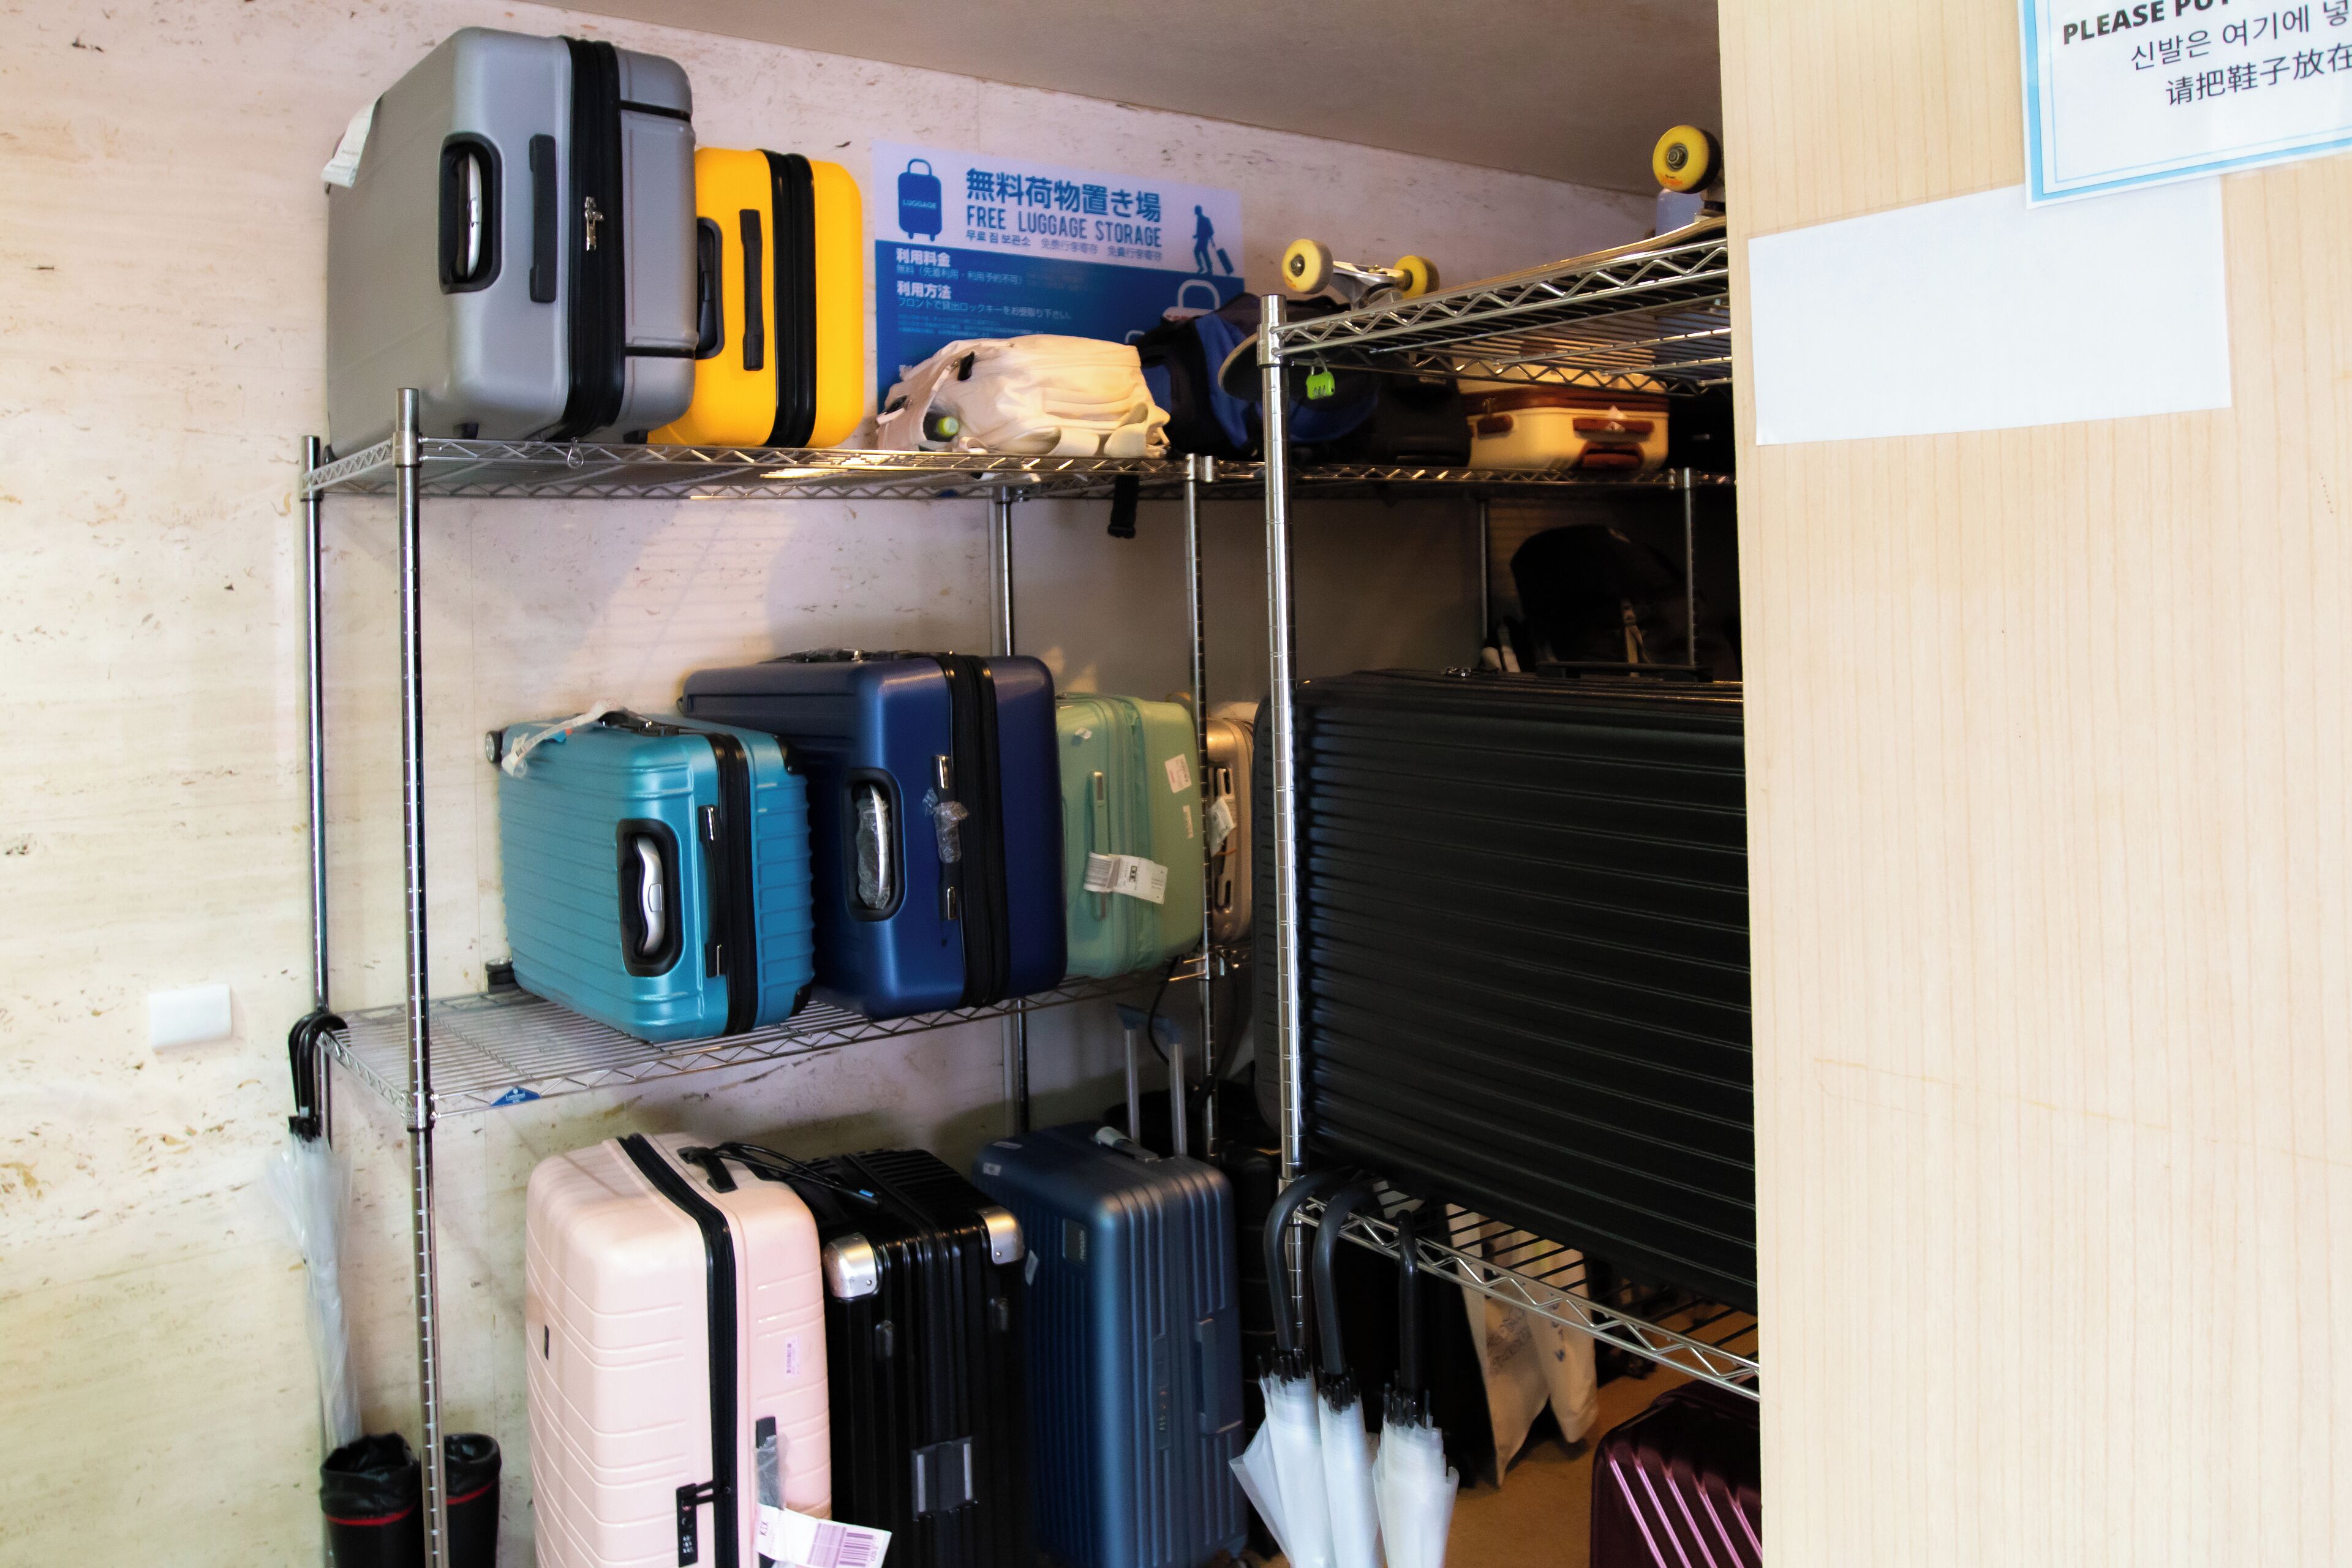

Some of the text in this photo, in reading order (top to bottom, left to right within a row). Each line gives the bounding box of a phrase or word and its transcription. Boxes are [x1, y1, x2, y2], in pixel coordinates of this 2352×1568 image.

[2064, 0, 2165, 45] PLEASE
[2131, 29, 2212, 70] 신발은
[2222, 4, 2309, 47] 여기에
[2165, 42, 2352, 105] 请把鞋子放在
[903, 198, 937, 209] LUGGAGE
[965, 167, 1161, 223] 無料荷物置き場
[966, 229, 1031, 246] 무료 짐 보관소
[967, 205, 1162, 248] FREE LUGGAGE STORAGE
[896, 247, 951, 268] 利用料金
[897, 280, 952, 300] 利用方法
[758, 1520, 769, 1537] KIX
